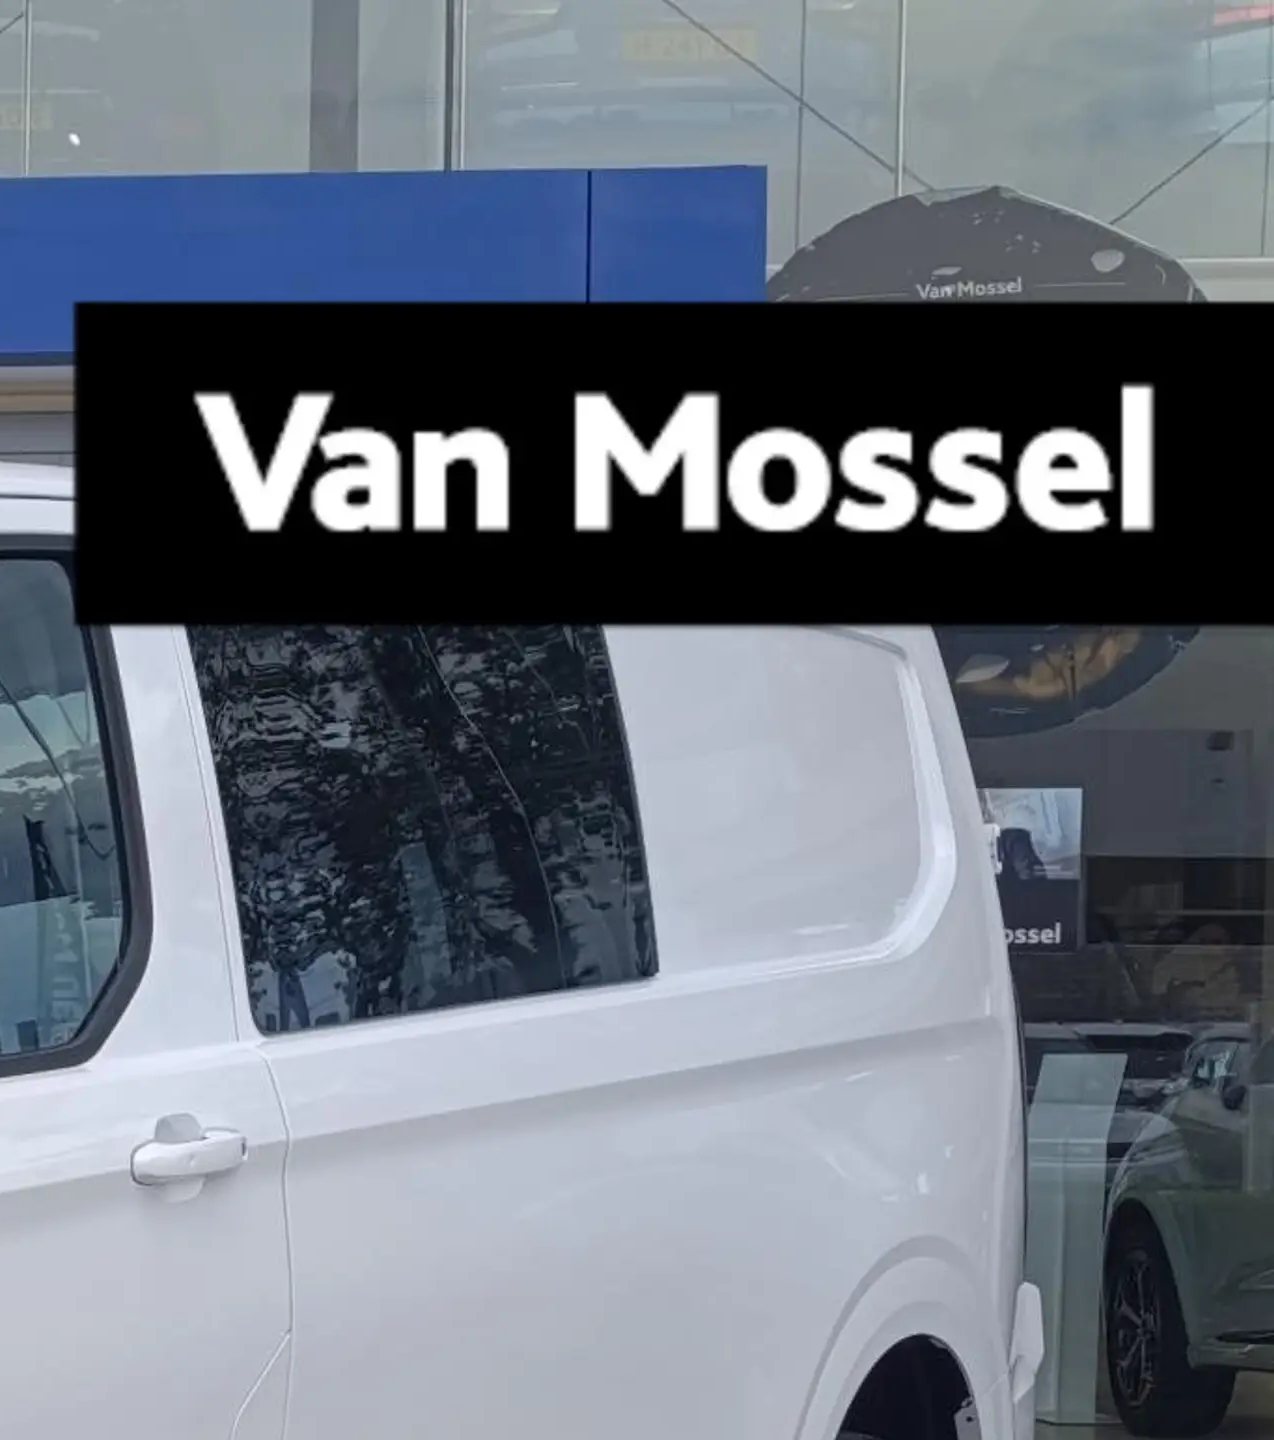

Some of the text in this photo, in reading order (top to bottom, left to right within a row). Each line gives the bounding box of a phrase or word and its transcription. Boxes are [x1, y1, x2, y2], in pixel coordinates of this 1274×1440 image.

[915, 276, 1022, 299] Van Mossel
[1003, 921, 1061, 945] ossel
